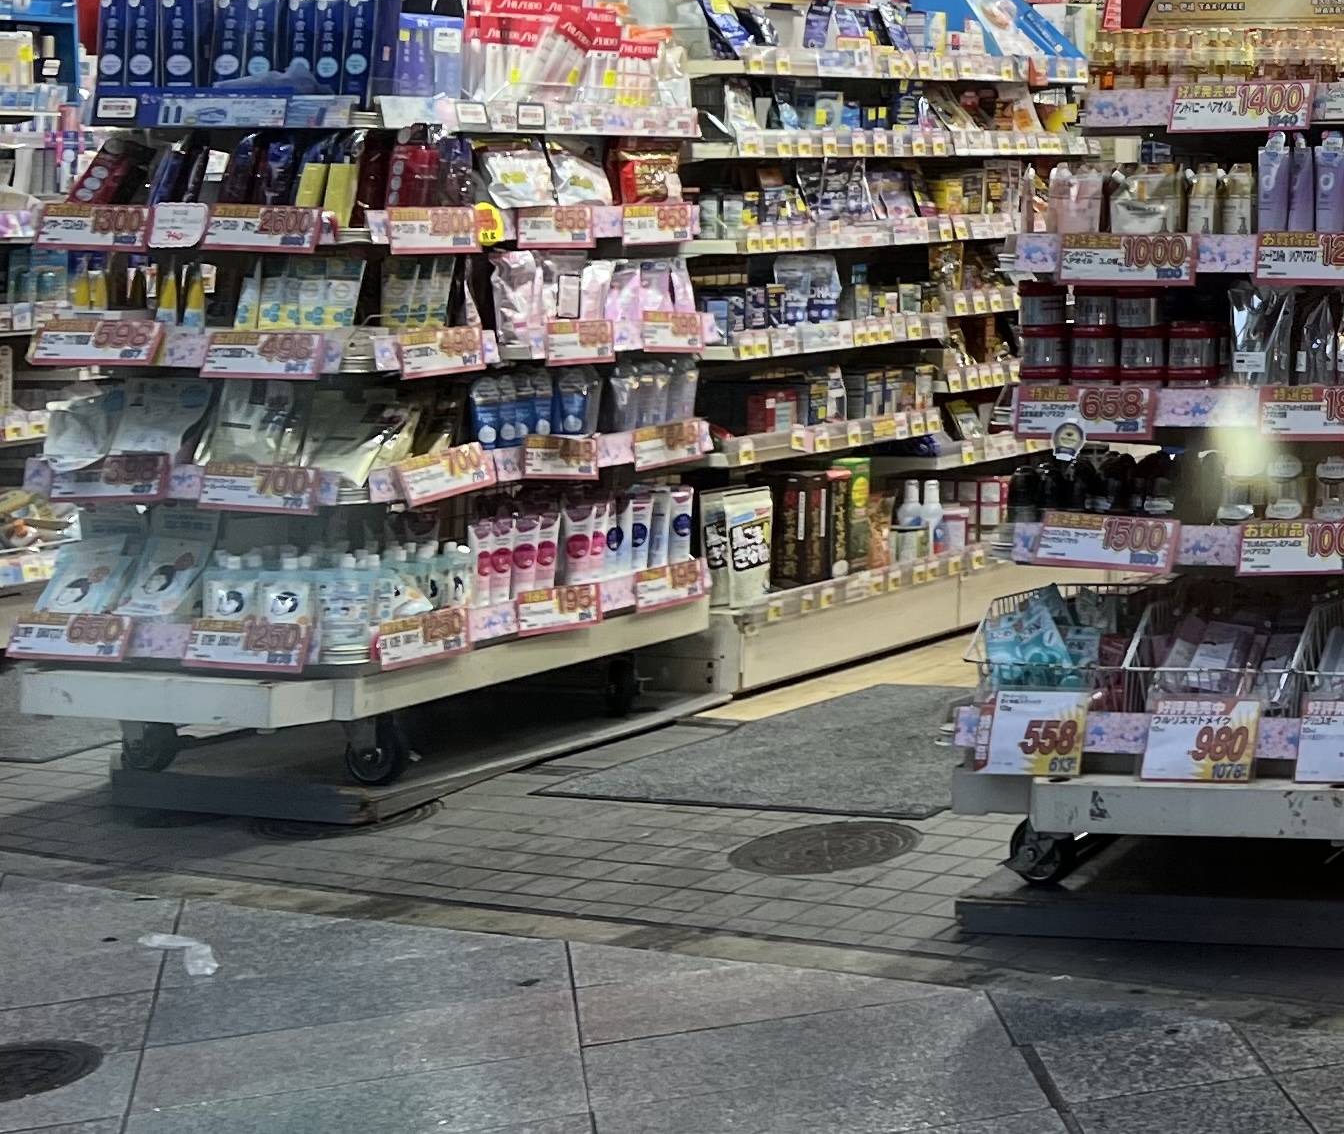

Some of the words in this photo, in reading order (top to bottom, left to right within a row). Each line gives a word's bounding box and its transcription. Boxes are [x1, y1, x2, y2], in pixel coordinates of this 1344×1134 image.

[1238, 83, 1305, 116] 1400
[91, 207, 143, 234] 1300
[259, 208, 313, 235] 2600
[1124, 234, 1188, 267] 1000
[1079, 387, 1144, 421] 658
[256, 466, 310, 496] 700
[1102, 518, 1168, 553] 1500
[243, 622, 301, 652] 1250
[1019, 720, 1080, 756] 558
[1193, 726, 1249, 763] 980
